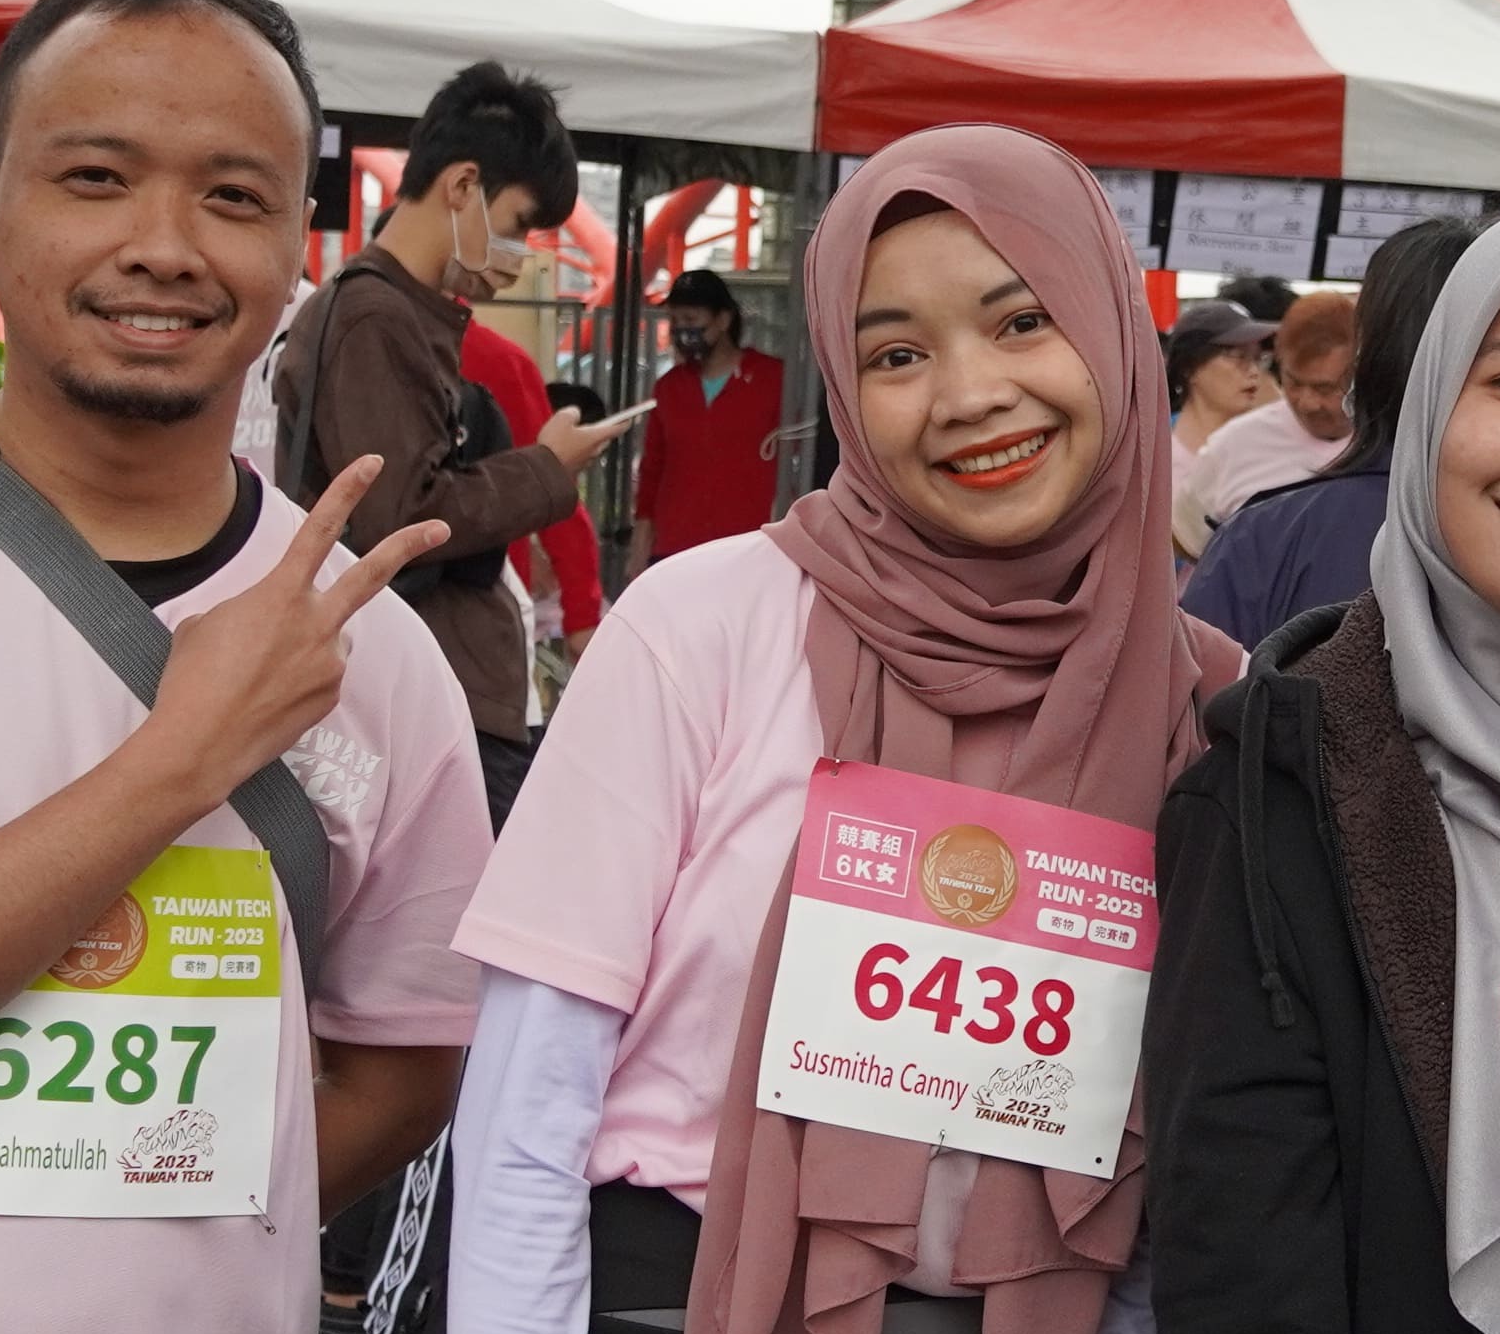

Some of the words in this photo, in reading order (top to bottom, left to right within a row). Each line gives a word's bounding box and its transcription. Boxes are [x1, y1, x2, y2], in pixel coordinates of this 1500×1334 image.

[835, 822, 903, 857] 競賽組
[835, 854, 898, 886] 6K女
[1024, 849, 1108, 885] TAIWAN
[1109, 870, 1157, 899] TECH
[152, 896, 233, 918] TAIWAN
[236, 899, 272, 918] TECH
[1038, 880, 1084, 907] RUN
[1095, 893, 1143, 920] 2023
[170, 926, 214, 946] RUN
[224, 928, 265, 946] 2023
[1051, 916, 1075, 932] 寄物
[1095, 925, 1130, 945] 完賽禮
[184, 960, 207, 974] 寄物
[224, 960, 255, 974] 完賽禮
[853, 942, 1076, 1056] 6438
[789, 1040, 894, 1091] Susmitha
[900, 1064, 969, 1112] Canny
[974, 1107, 1031, 1128] TAIWAN
[1033, 1118, 1066, 1136] TECH
[1005, 1099, 1052, 1118] 2023
[123, 1171, 178, 1183] TAIWAN
[182, 1170, 214, 1183] TECH
[153, 1155, 197, 1169] 2023
